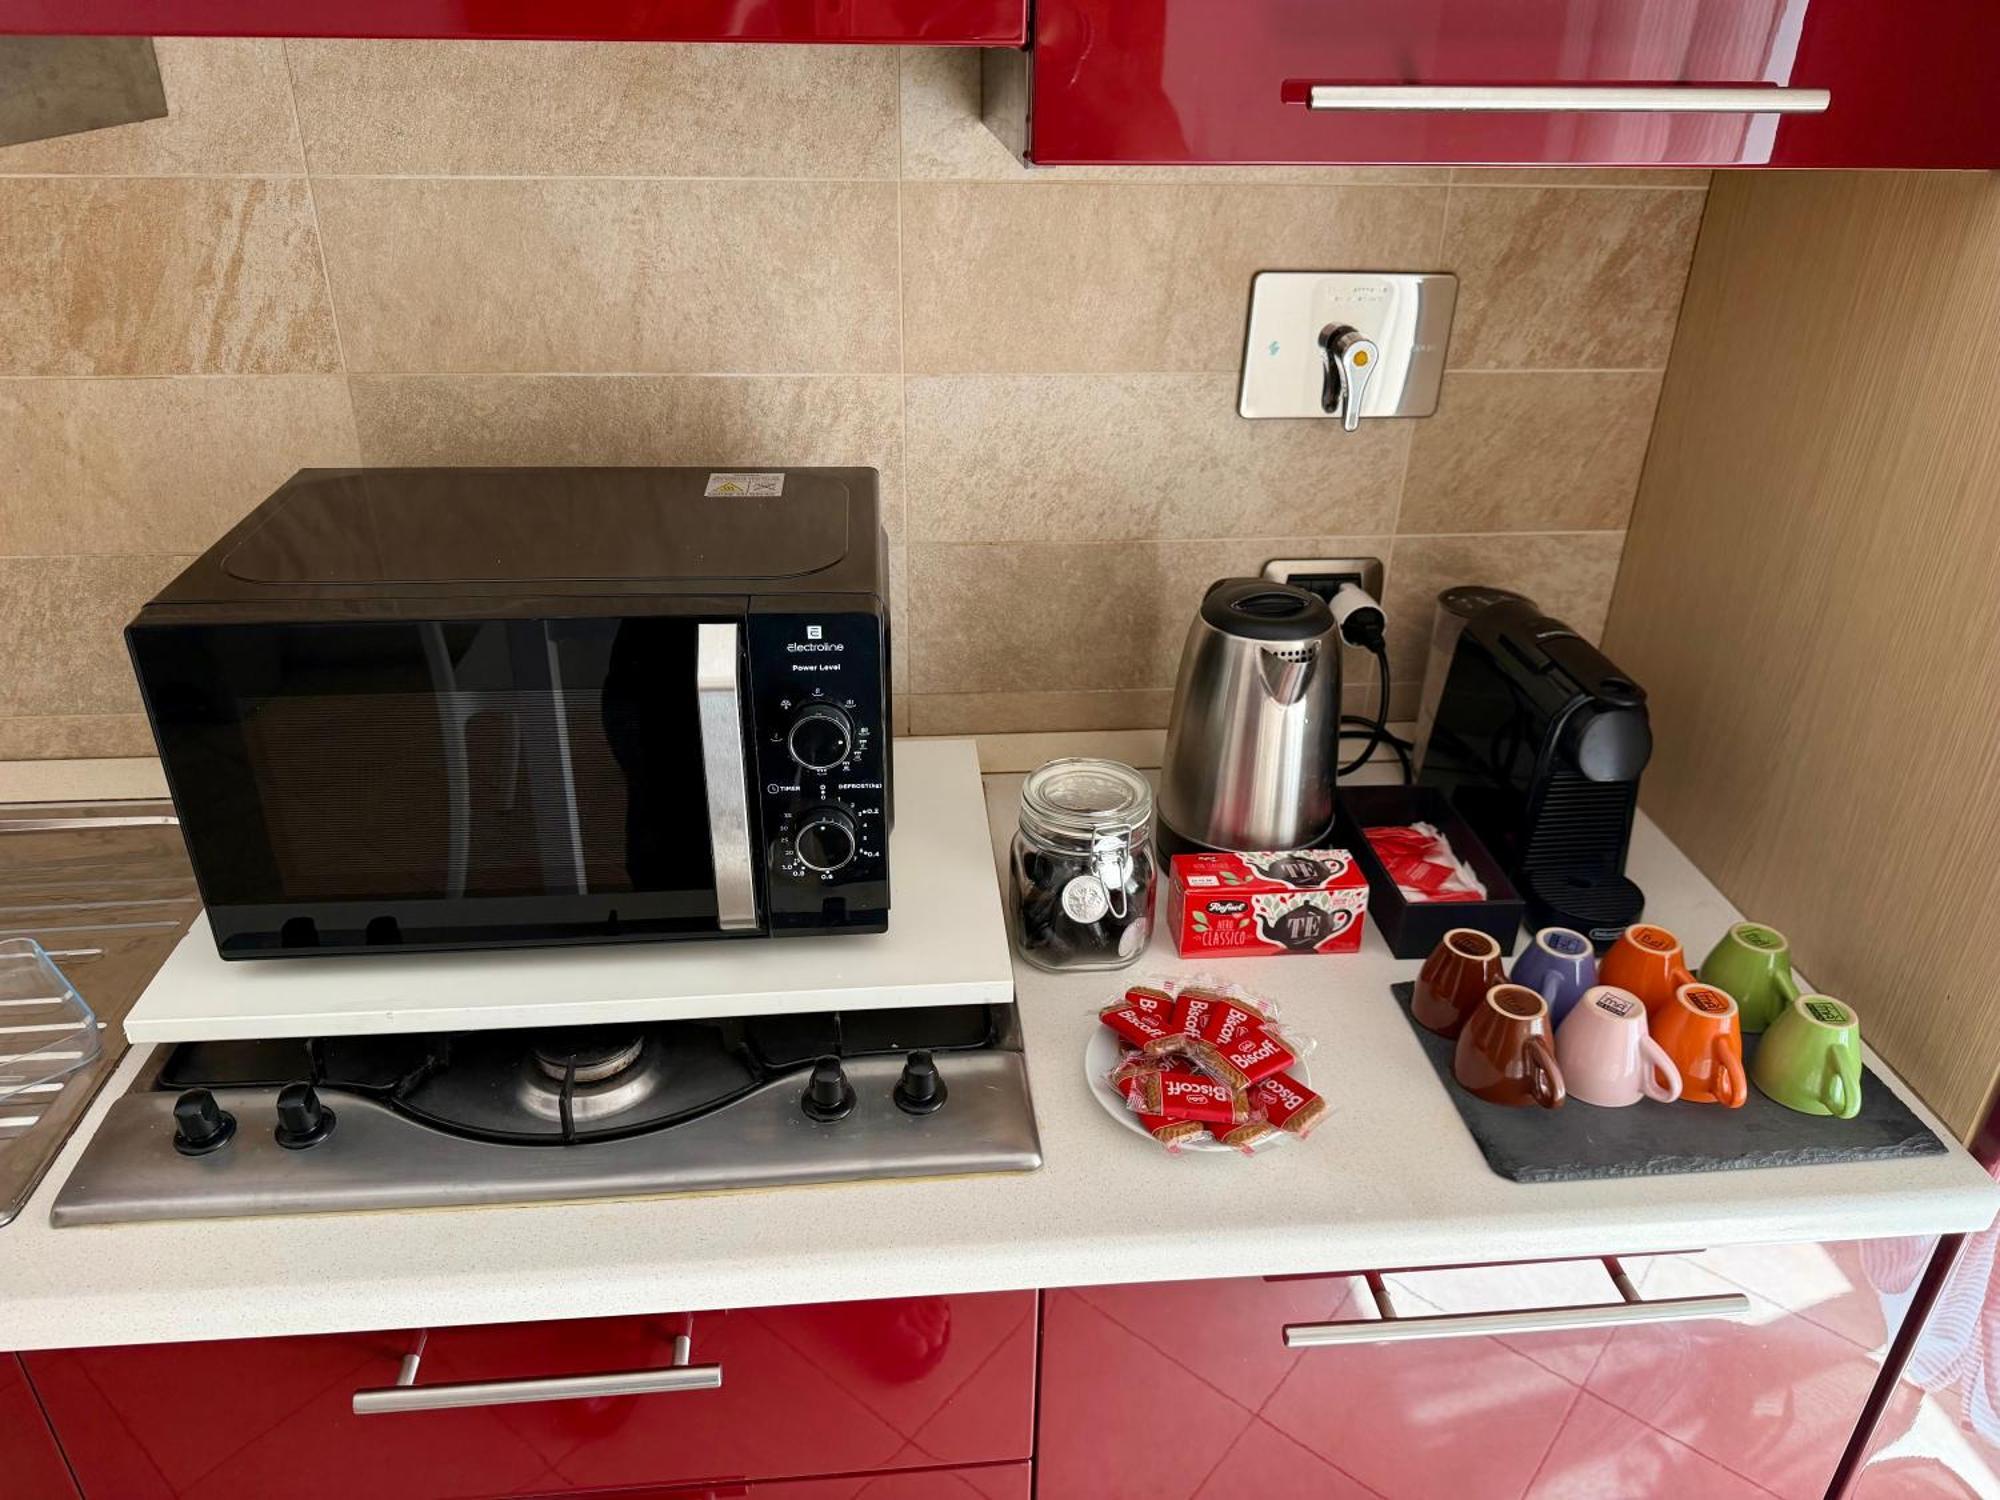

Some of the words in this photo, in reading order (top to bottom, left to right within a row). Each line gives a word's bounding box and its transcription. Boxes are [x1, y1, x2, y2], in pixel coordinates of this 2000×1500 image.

[819, 663, 841, 671] Level
[1201, 930, 1247, 947] CLASSICO
[1287, 911, 1321, 939] TÈ
[1118, 1009, 1168, 1038] Biscoff
[1184, 1000, 1209, 1039] Biscoff
[1229, 1038, 1281, 1069] Biscoff
[1164, 1080, 1227, 1102] Biscoff
